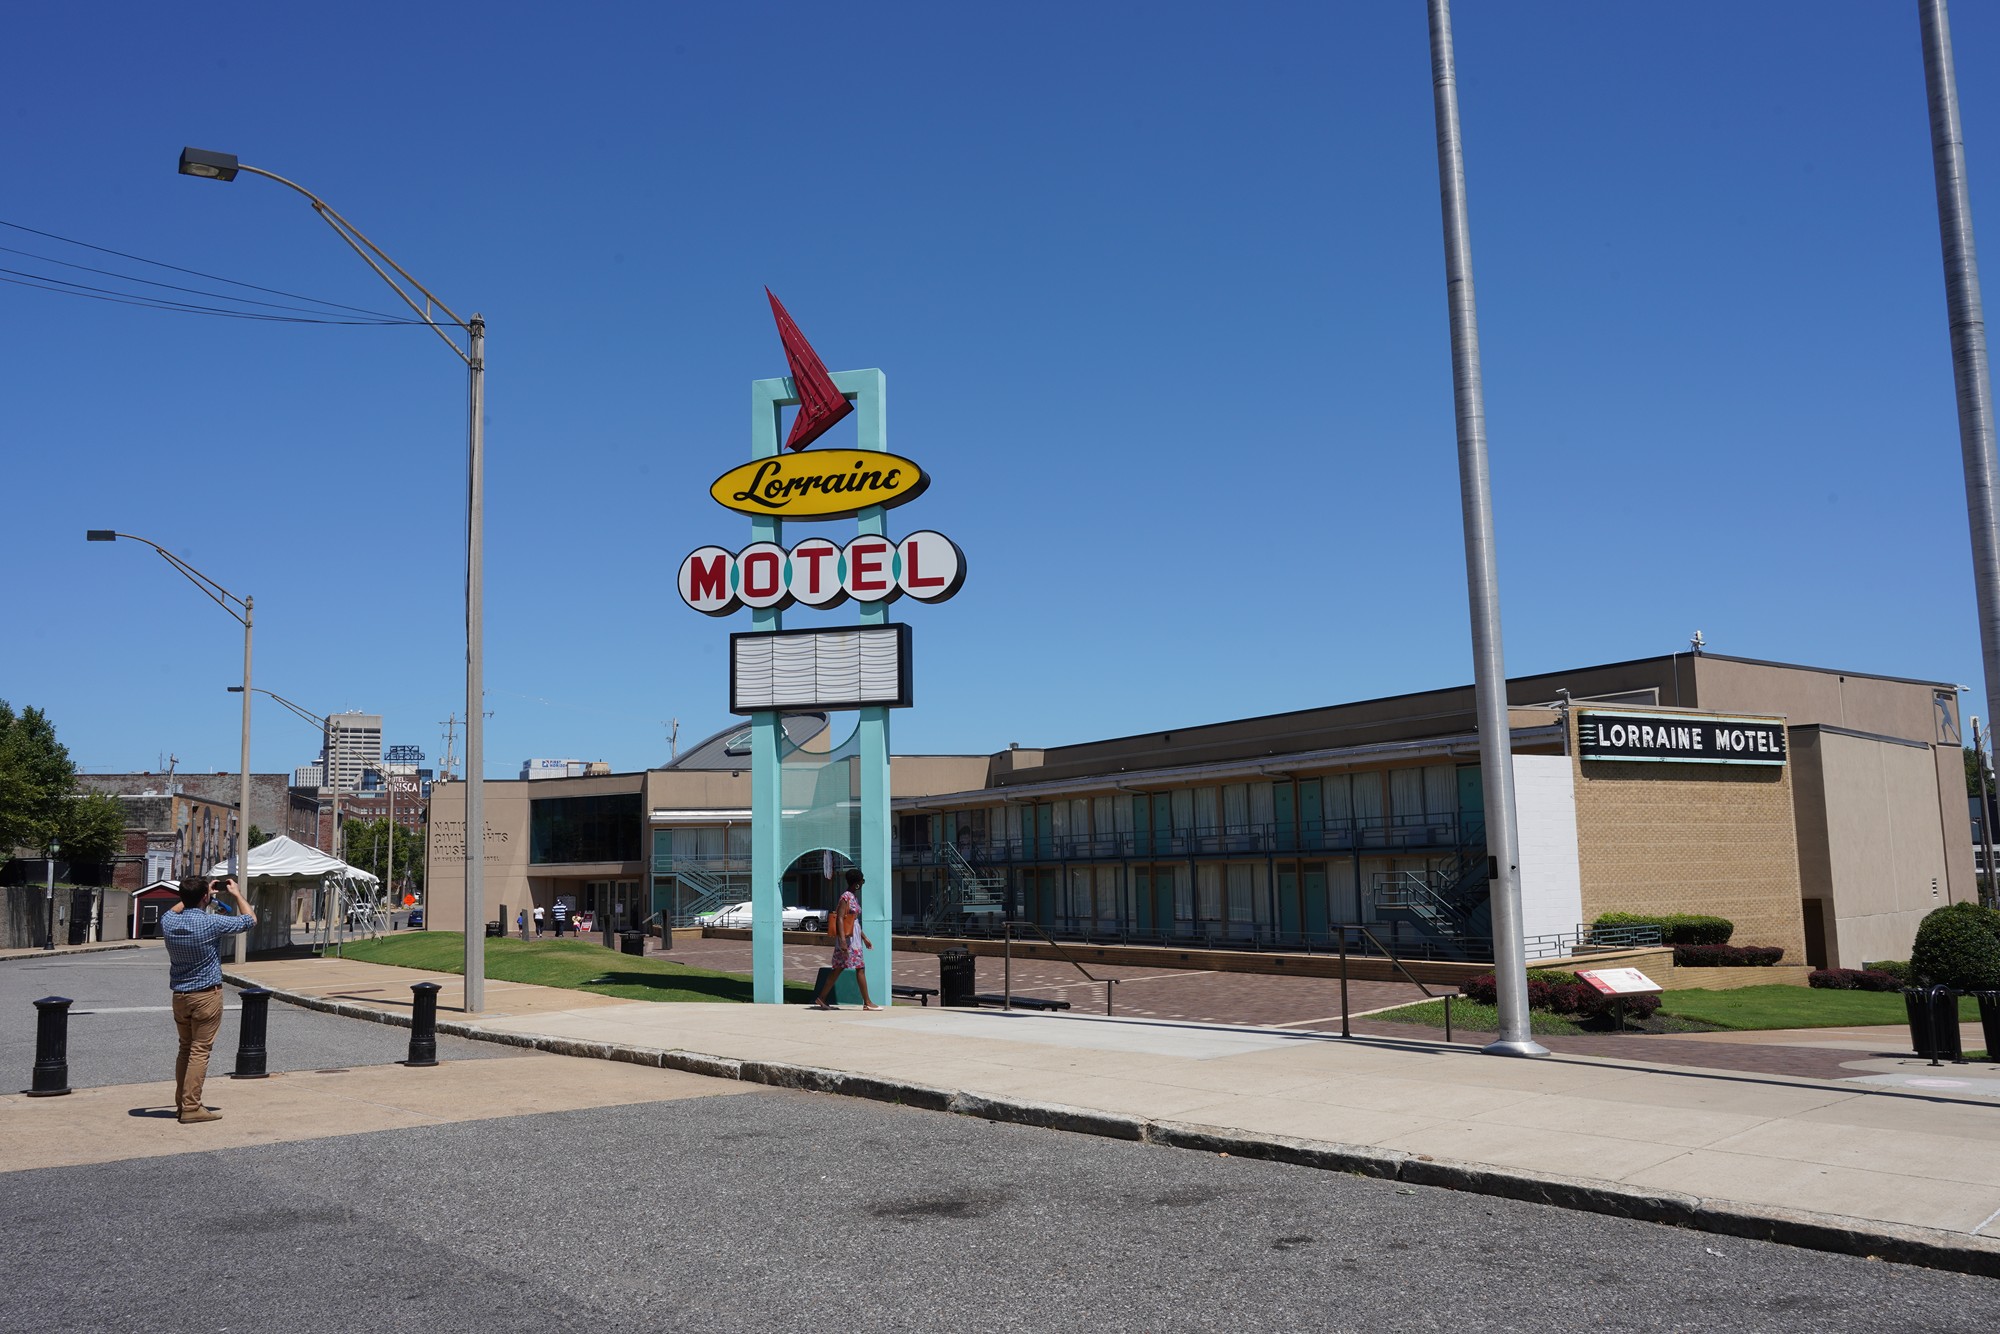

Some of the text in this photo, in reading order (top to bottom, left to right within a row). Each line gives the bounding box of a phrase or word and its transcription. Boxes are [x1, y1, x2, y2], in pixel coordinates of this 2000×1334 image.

[732, 459, 901, 508] Lorraine
[690, 541, 945, 602] MOTEL
[1598, 723, 1780, 754] LORRAINE MOTEL
[434, 821, 492, 832] NATIL
[434, 833, 464, 843] CIVIL
